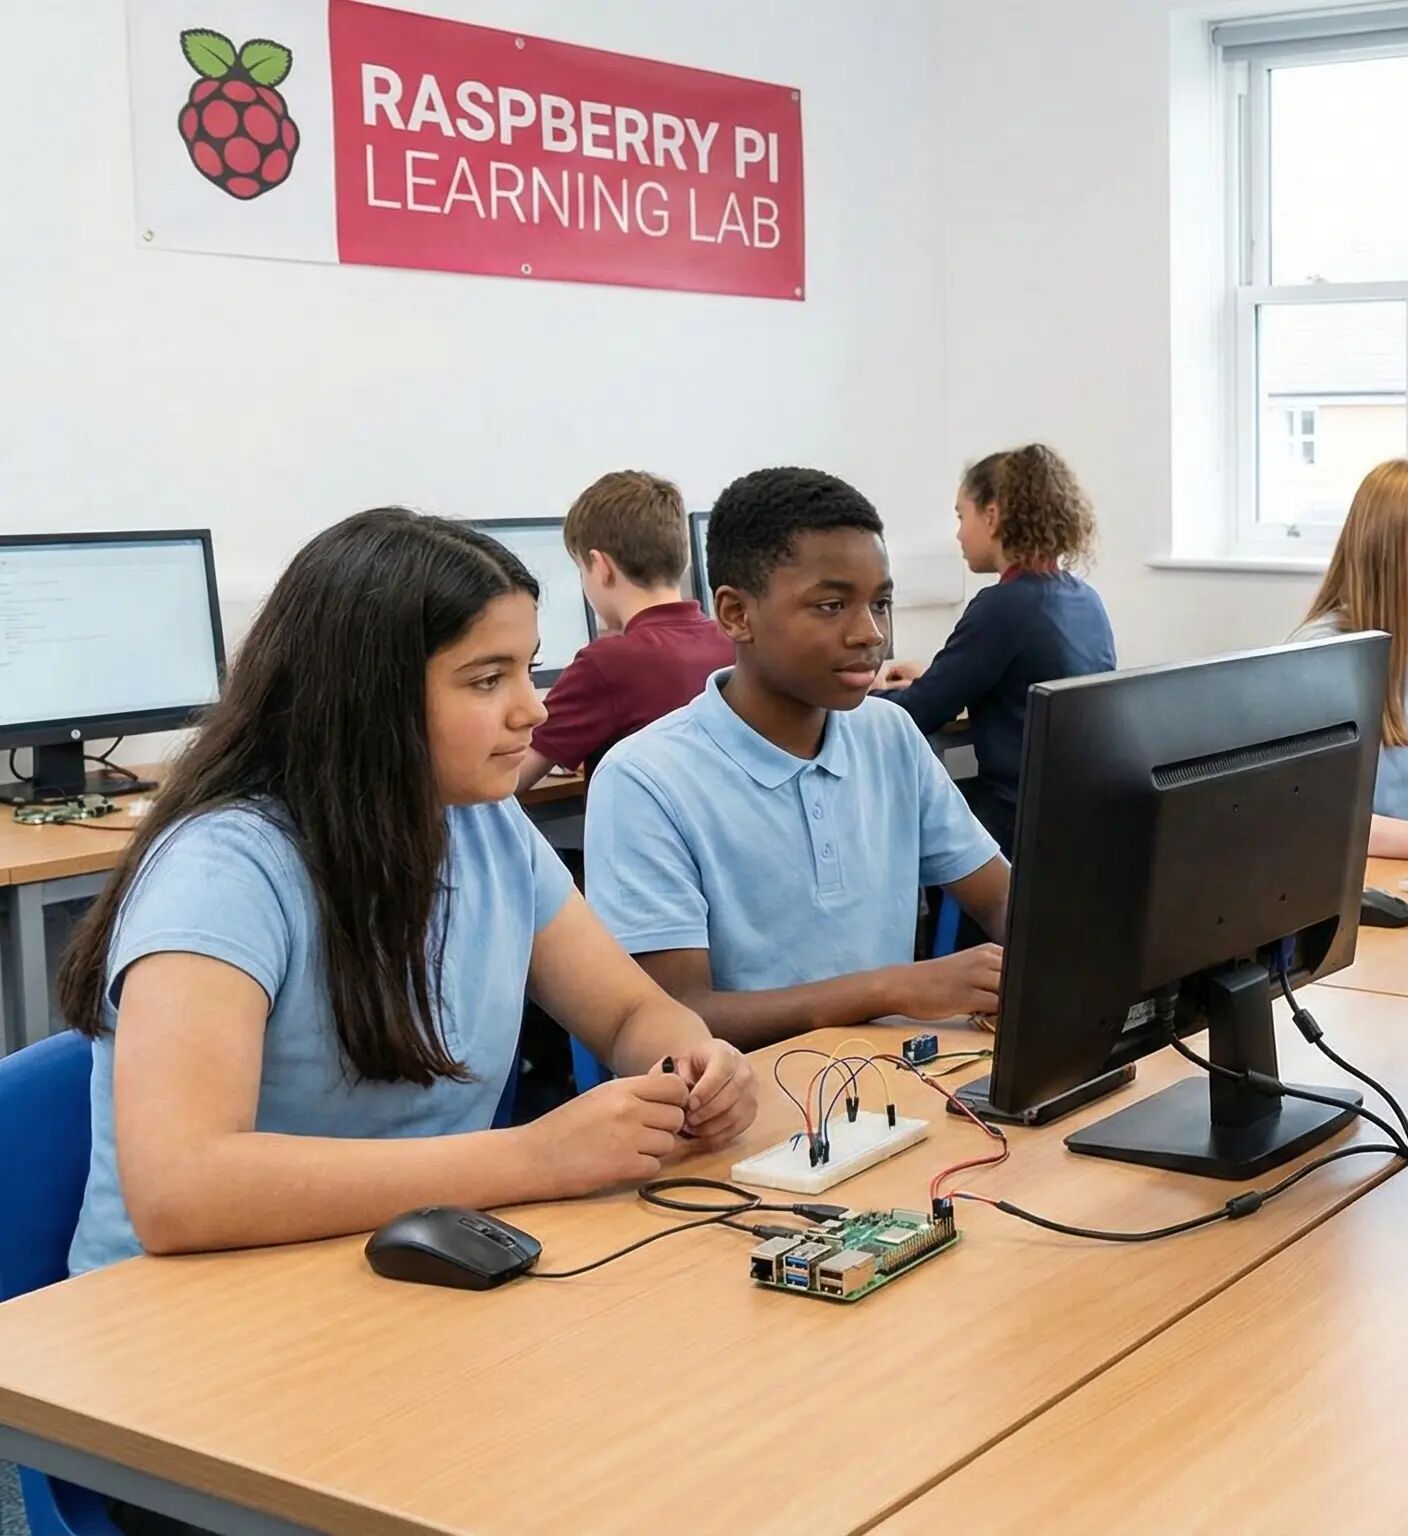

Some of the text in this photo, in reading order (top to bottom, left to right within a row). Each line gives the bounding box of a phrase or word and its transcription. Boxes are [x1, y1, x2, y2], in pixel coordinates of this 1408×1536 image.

[361, 63, 779, 184] RASPBERRY PI
[364, 144, 781, 249] LEARNING LAB
